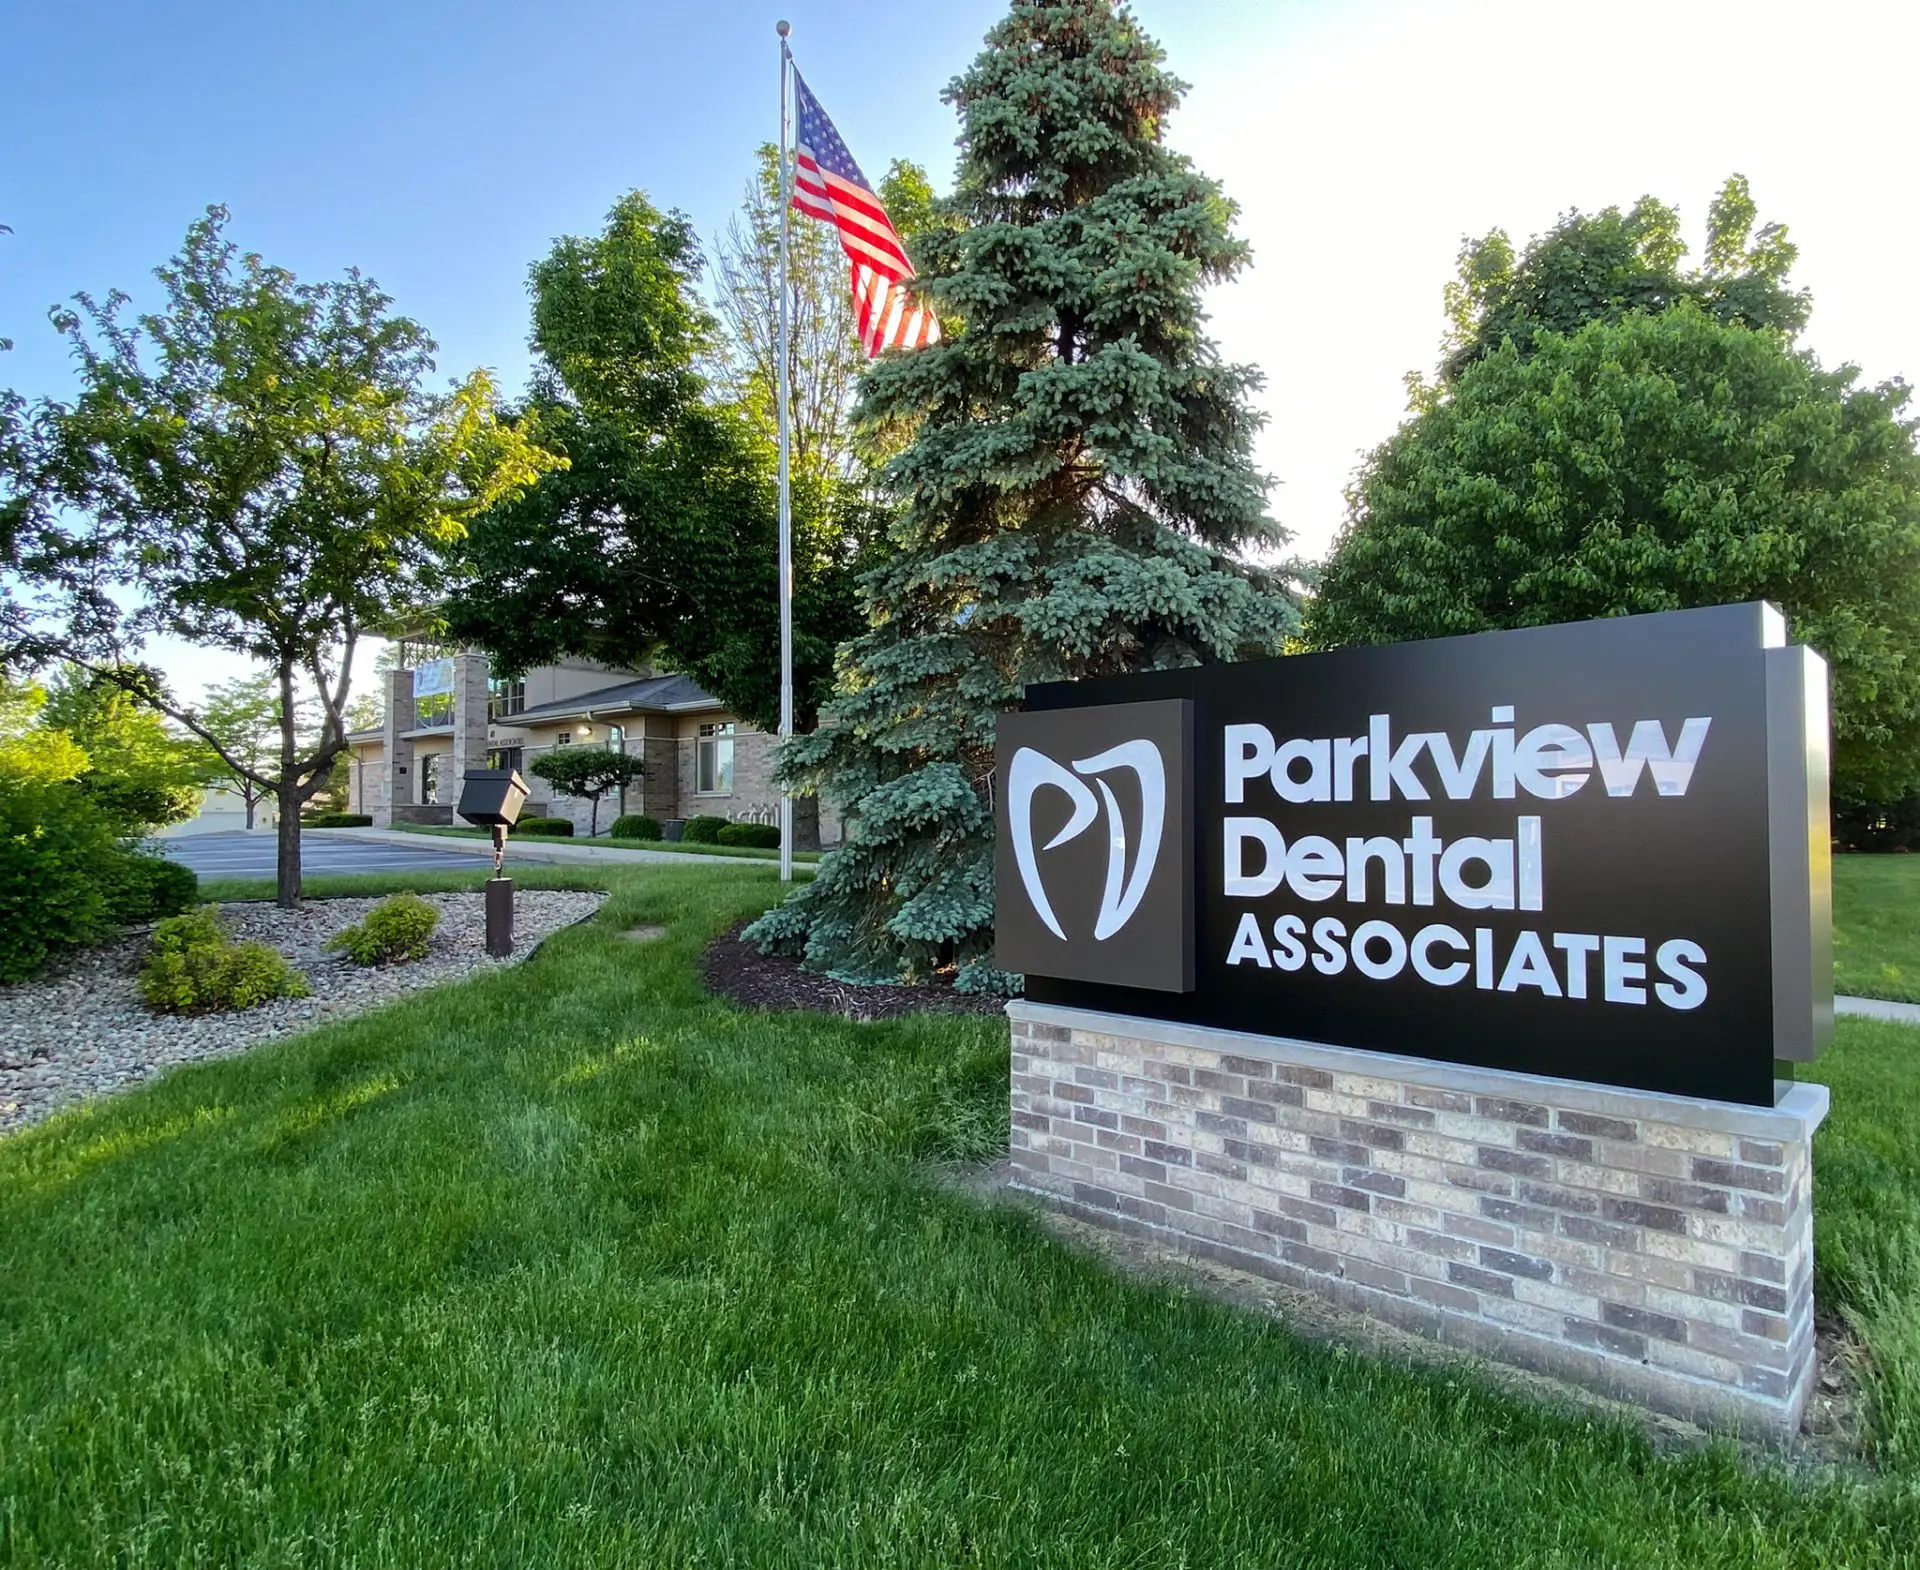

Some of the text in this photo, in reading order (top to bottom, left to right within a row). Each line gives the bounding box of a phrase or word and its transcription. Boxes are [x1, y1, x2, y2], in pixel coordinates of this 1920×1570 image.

[1223, 704, 1713, 804] Parkview
[1223, 815, 1544, 912] Dental
[1225, 912, 1708, 1010] ASSOCIATES
